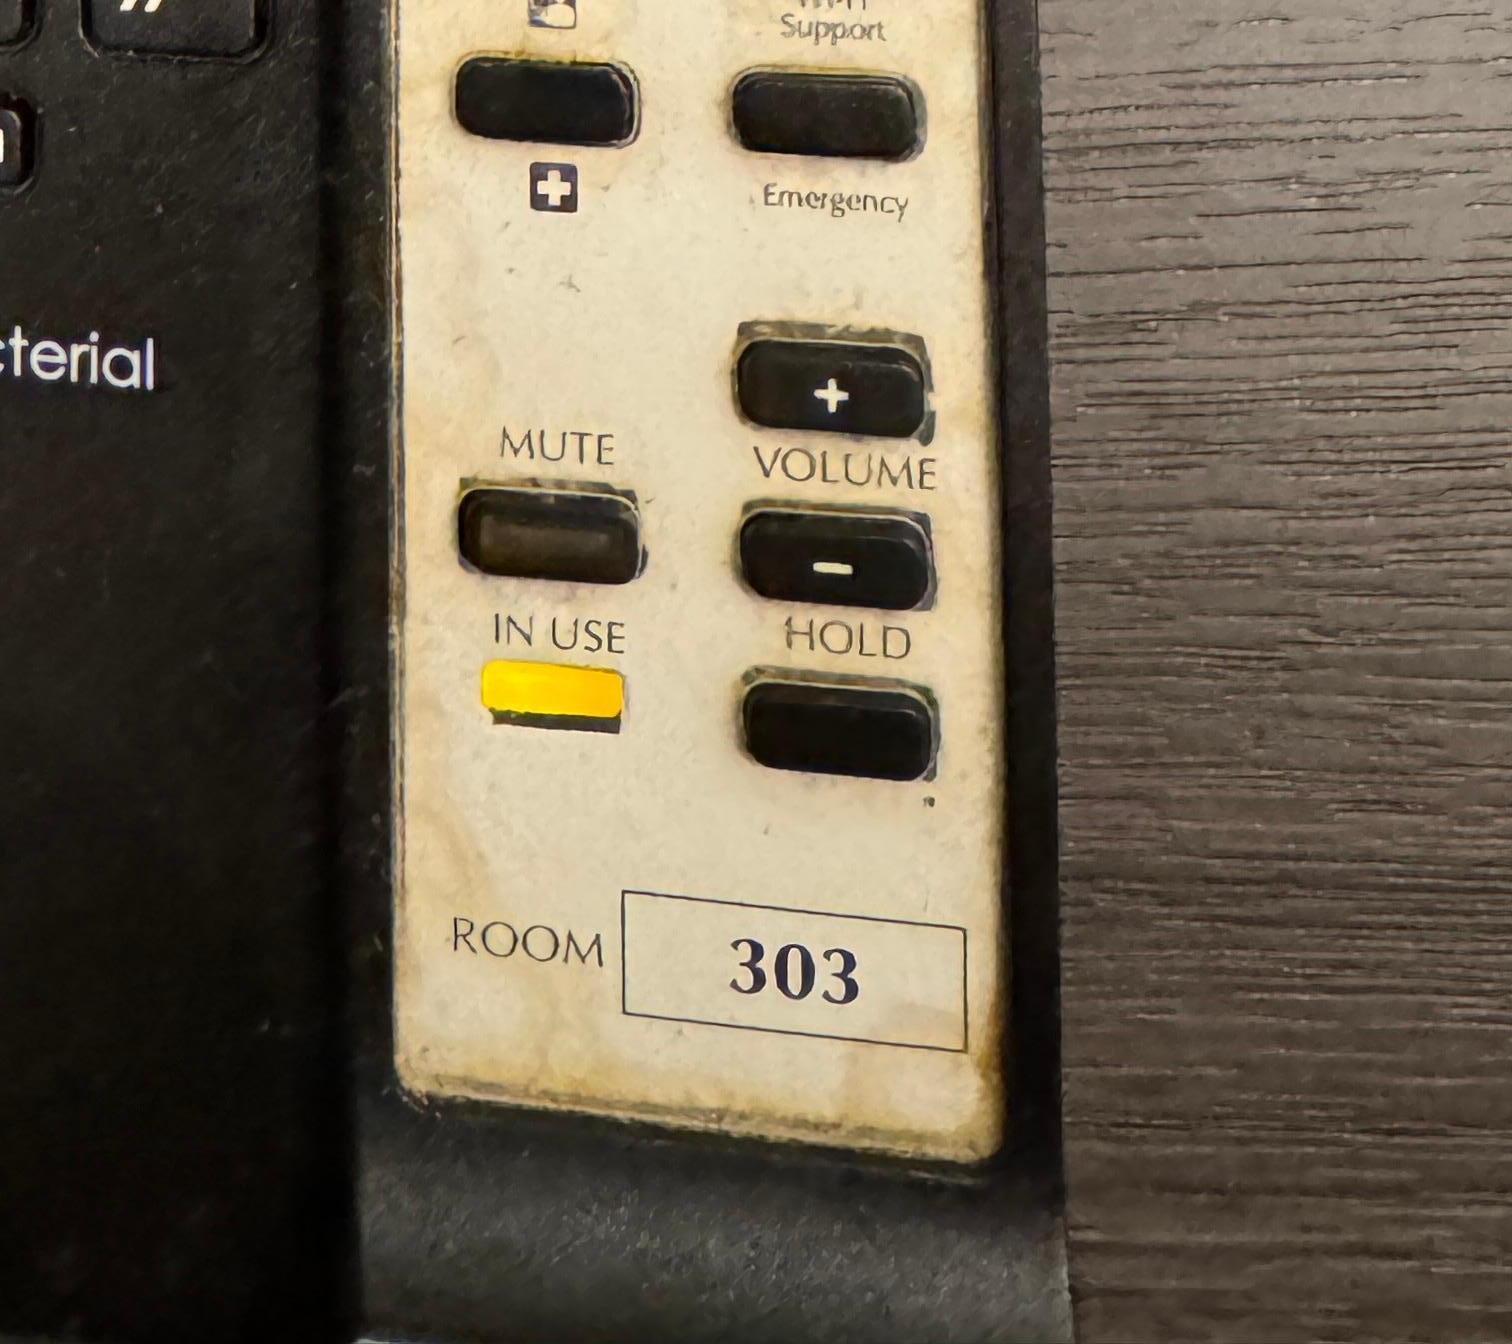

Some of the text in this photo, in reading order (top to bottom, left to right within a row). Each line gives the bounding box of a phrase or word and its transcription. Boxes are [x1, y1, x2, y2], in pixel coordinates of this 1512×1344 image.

[781, 14, 887, 45] Support
[764, 183, 909, 221] Emergency
[499, 425, 616, 466] MUTE
[753, 446, 939, 490] VOLUME
[492, 613, 627, 654] IN USE
[785, 616, 911, 659] HOLD
[452, 917, 860, 1005] ROOM 303
